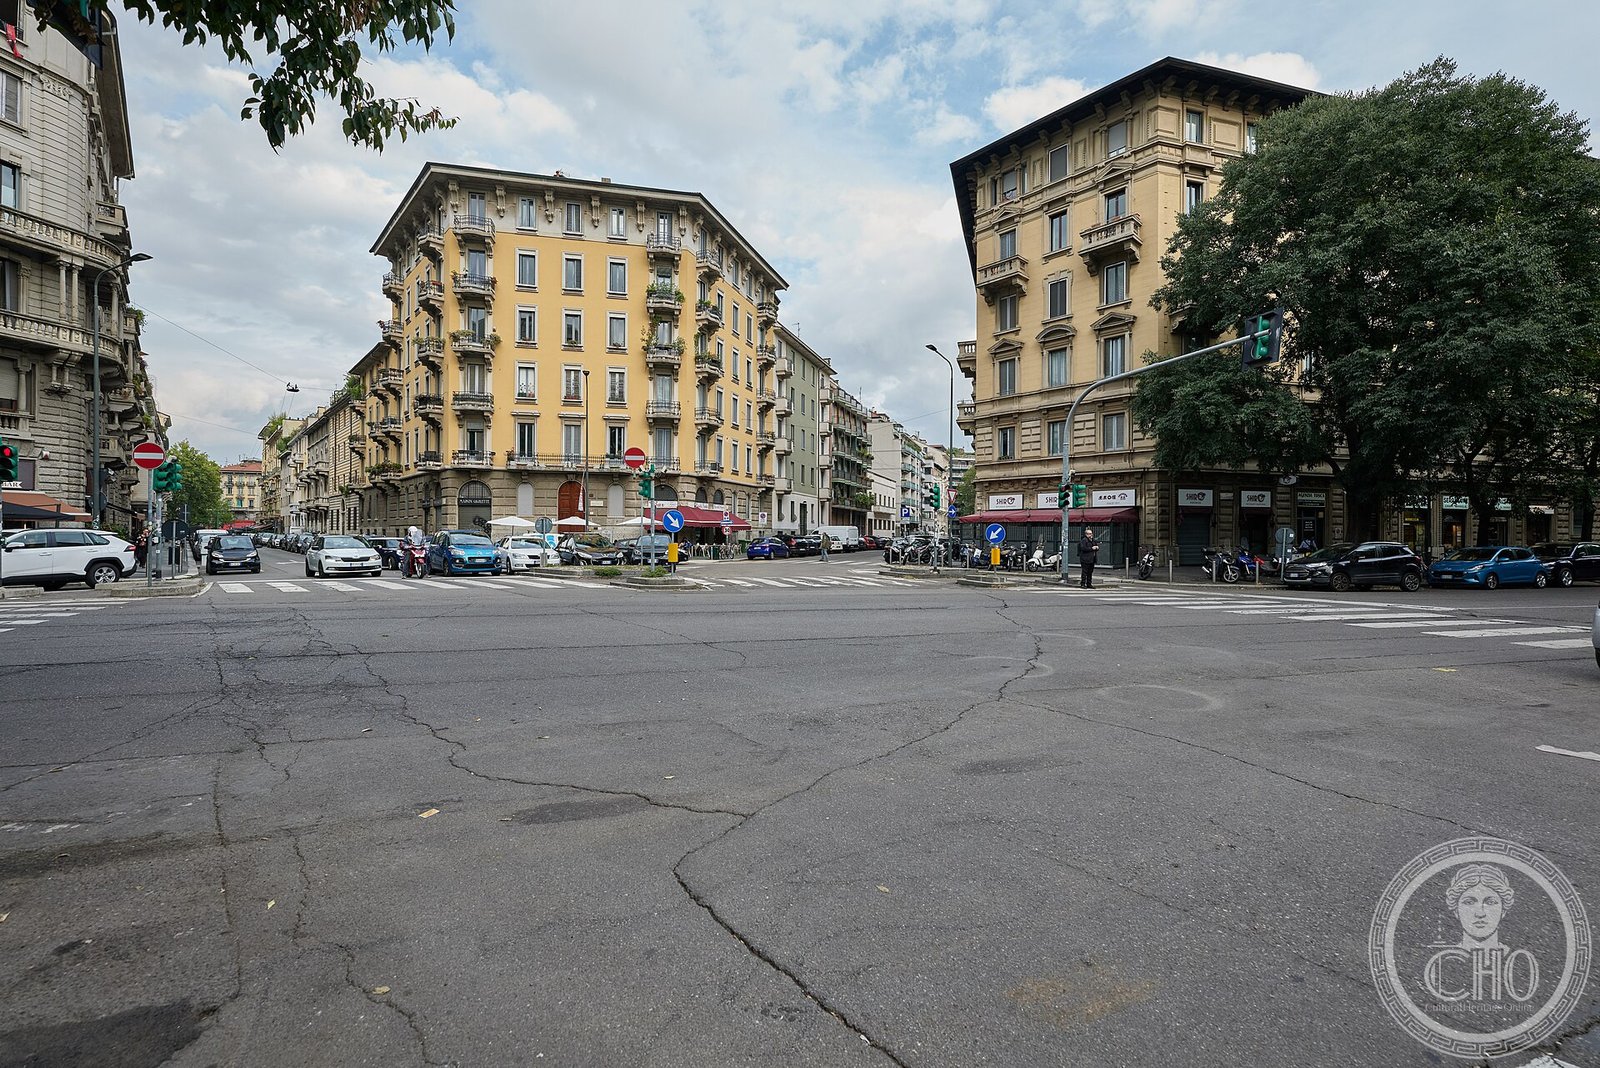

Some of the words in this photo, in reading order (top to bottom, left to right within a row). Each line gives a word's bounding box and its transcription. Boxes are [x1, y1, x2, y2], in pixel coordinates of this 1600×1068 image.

[1186, 492, 1206, 500] SHIRO
[1246, 494, 1266, 502] SHIRO
[996, 496, 1016, 505] SHIRO
[902, 508, 908, 516] P
